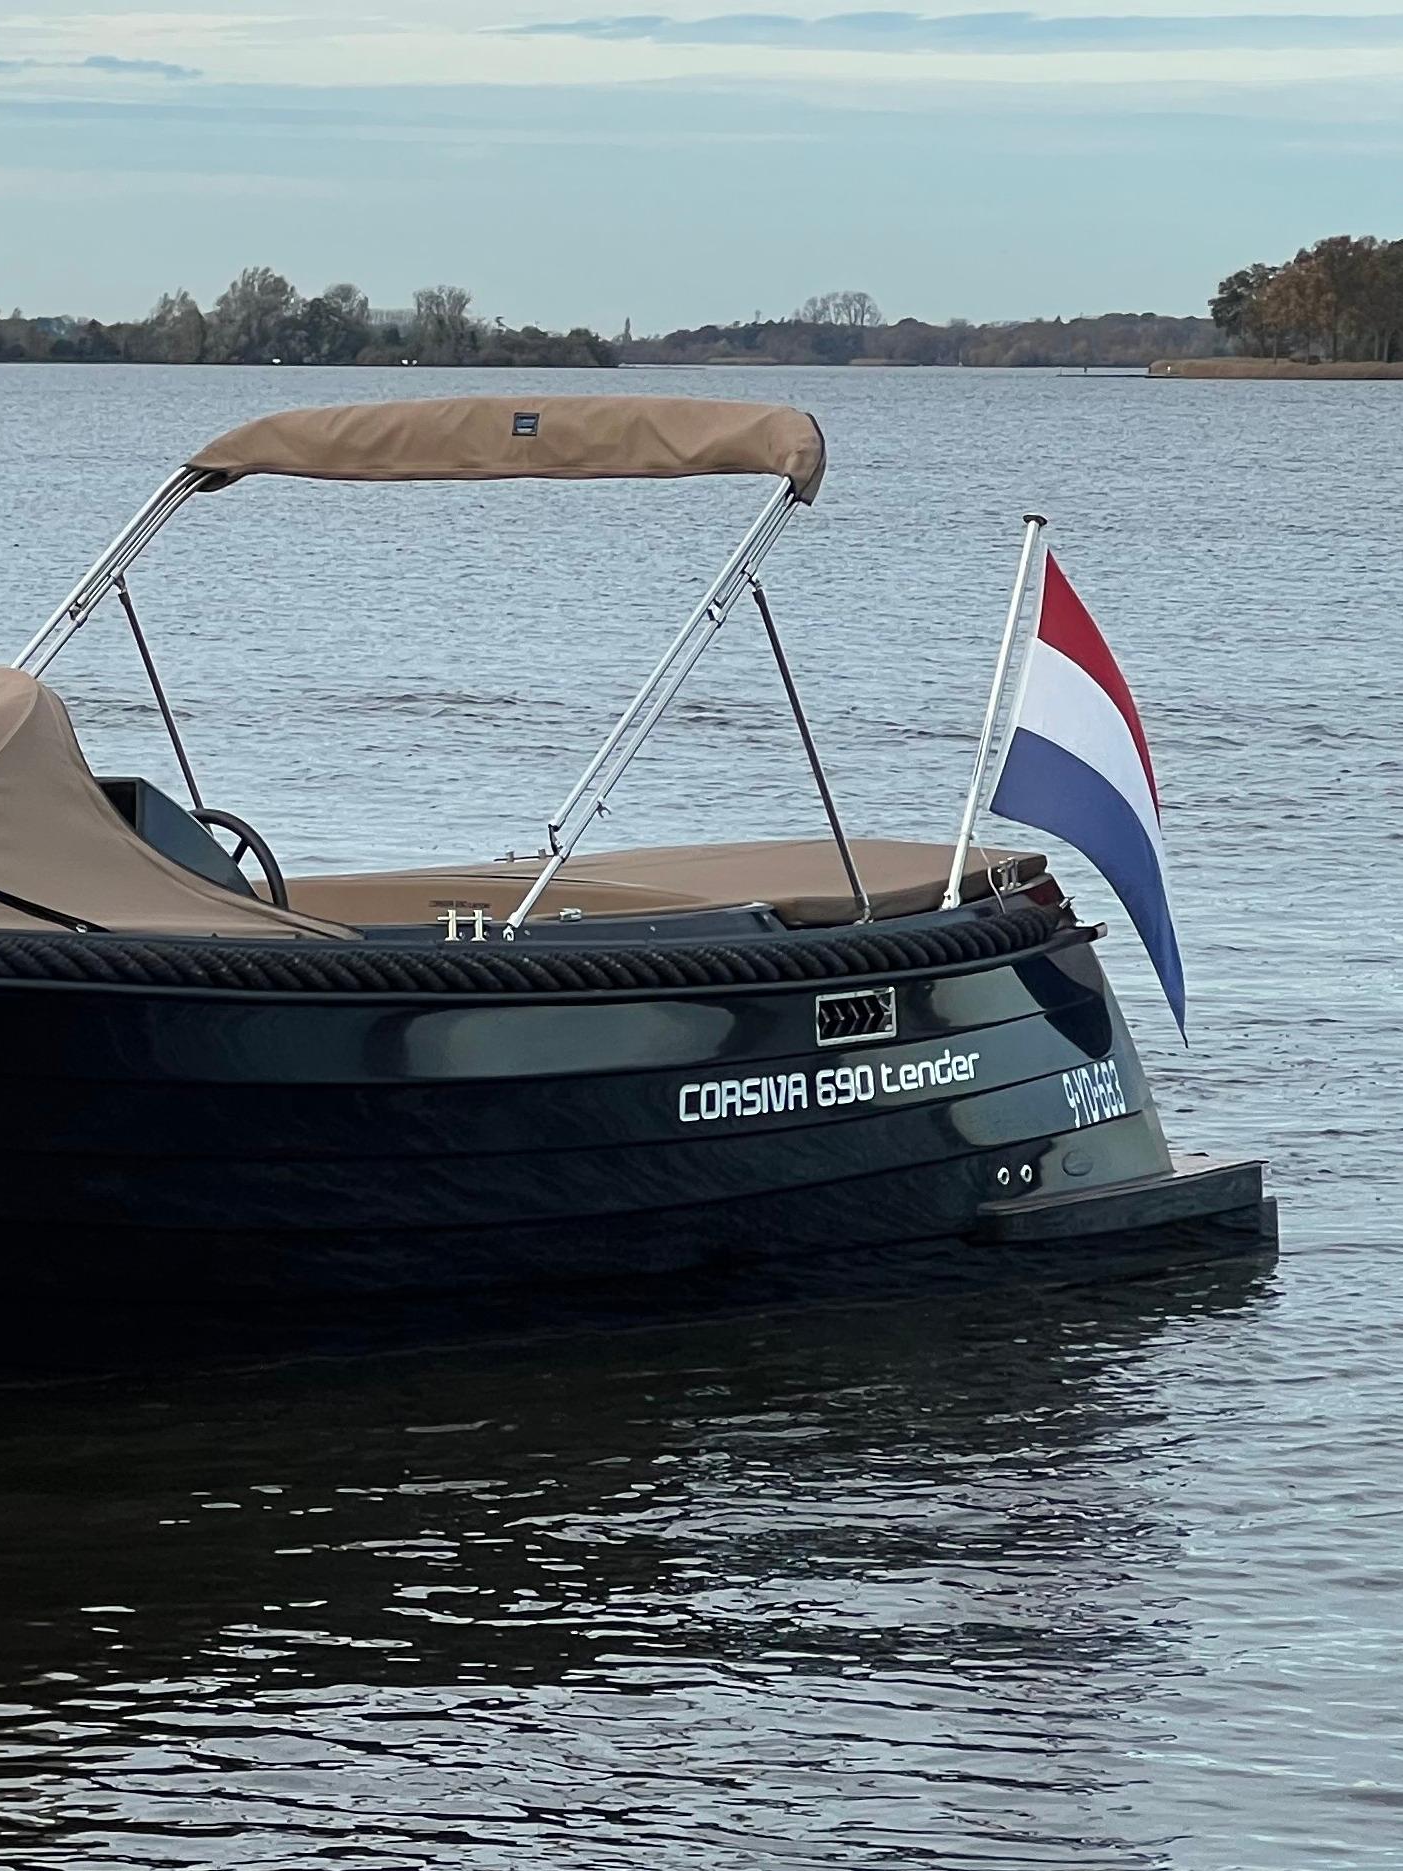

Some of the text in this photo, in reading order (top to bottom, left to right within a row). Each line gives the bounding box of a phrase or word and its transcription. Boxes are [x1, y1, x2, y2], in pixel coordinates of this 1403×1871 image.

[679, 1049, 980, 1122] CORSIVA 690 tender
[1062, 1059, 1127, 1129] 9-YD-683
